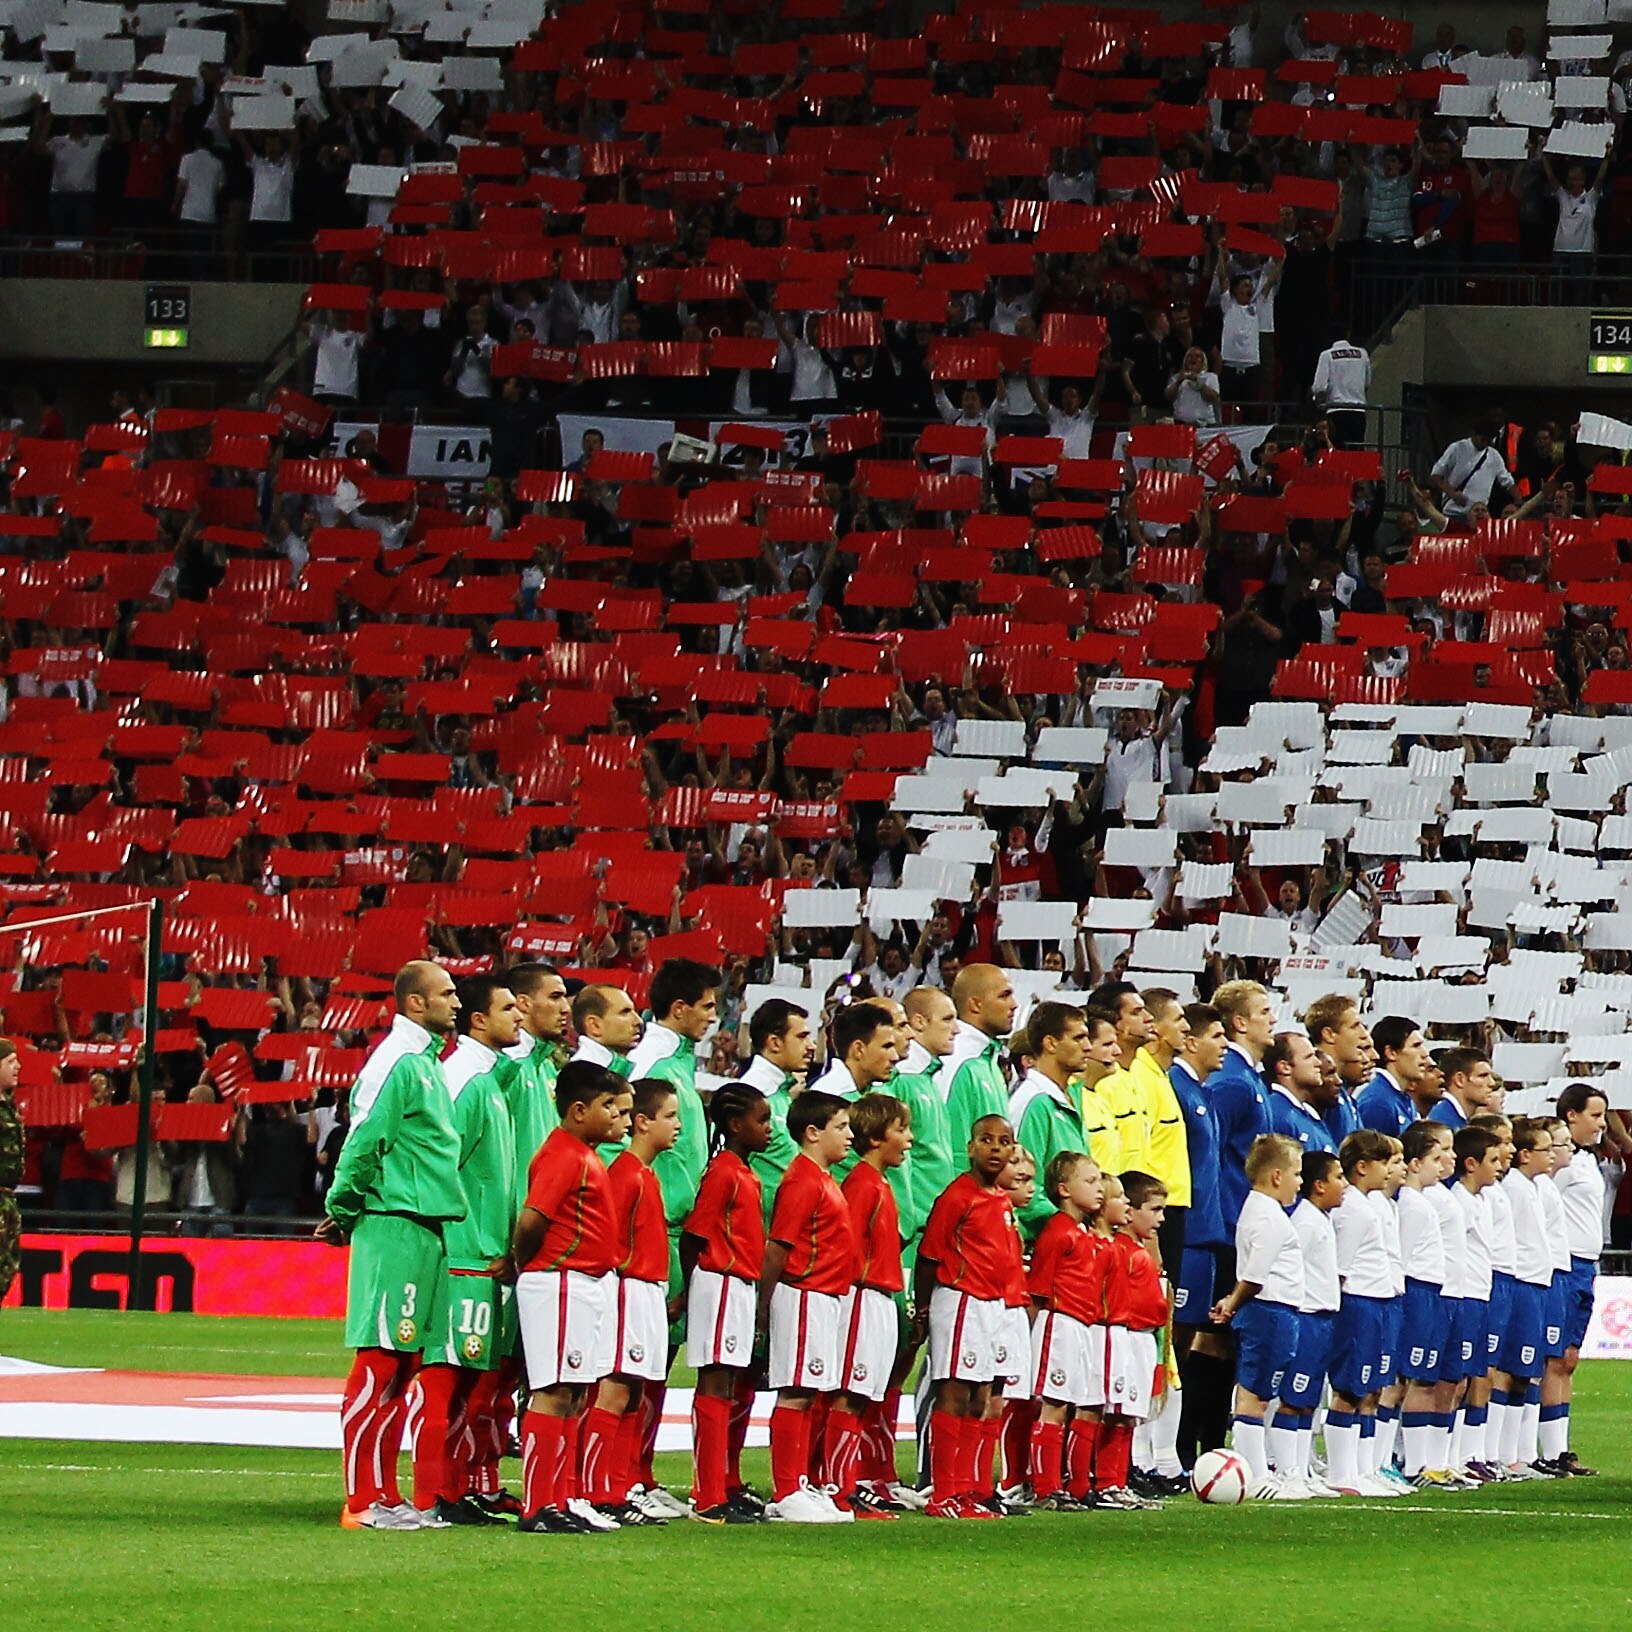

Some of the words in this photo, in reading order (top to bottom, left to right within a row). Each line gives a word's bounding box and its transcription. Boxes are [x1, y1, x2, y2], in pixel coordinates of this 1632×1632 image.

[149, 299, 188, 319] 133
[1592, 324, 1632, 345] 134
[401, 1282, 417, 1318] 3
[458, 1298, 492, 1336] 10
